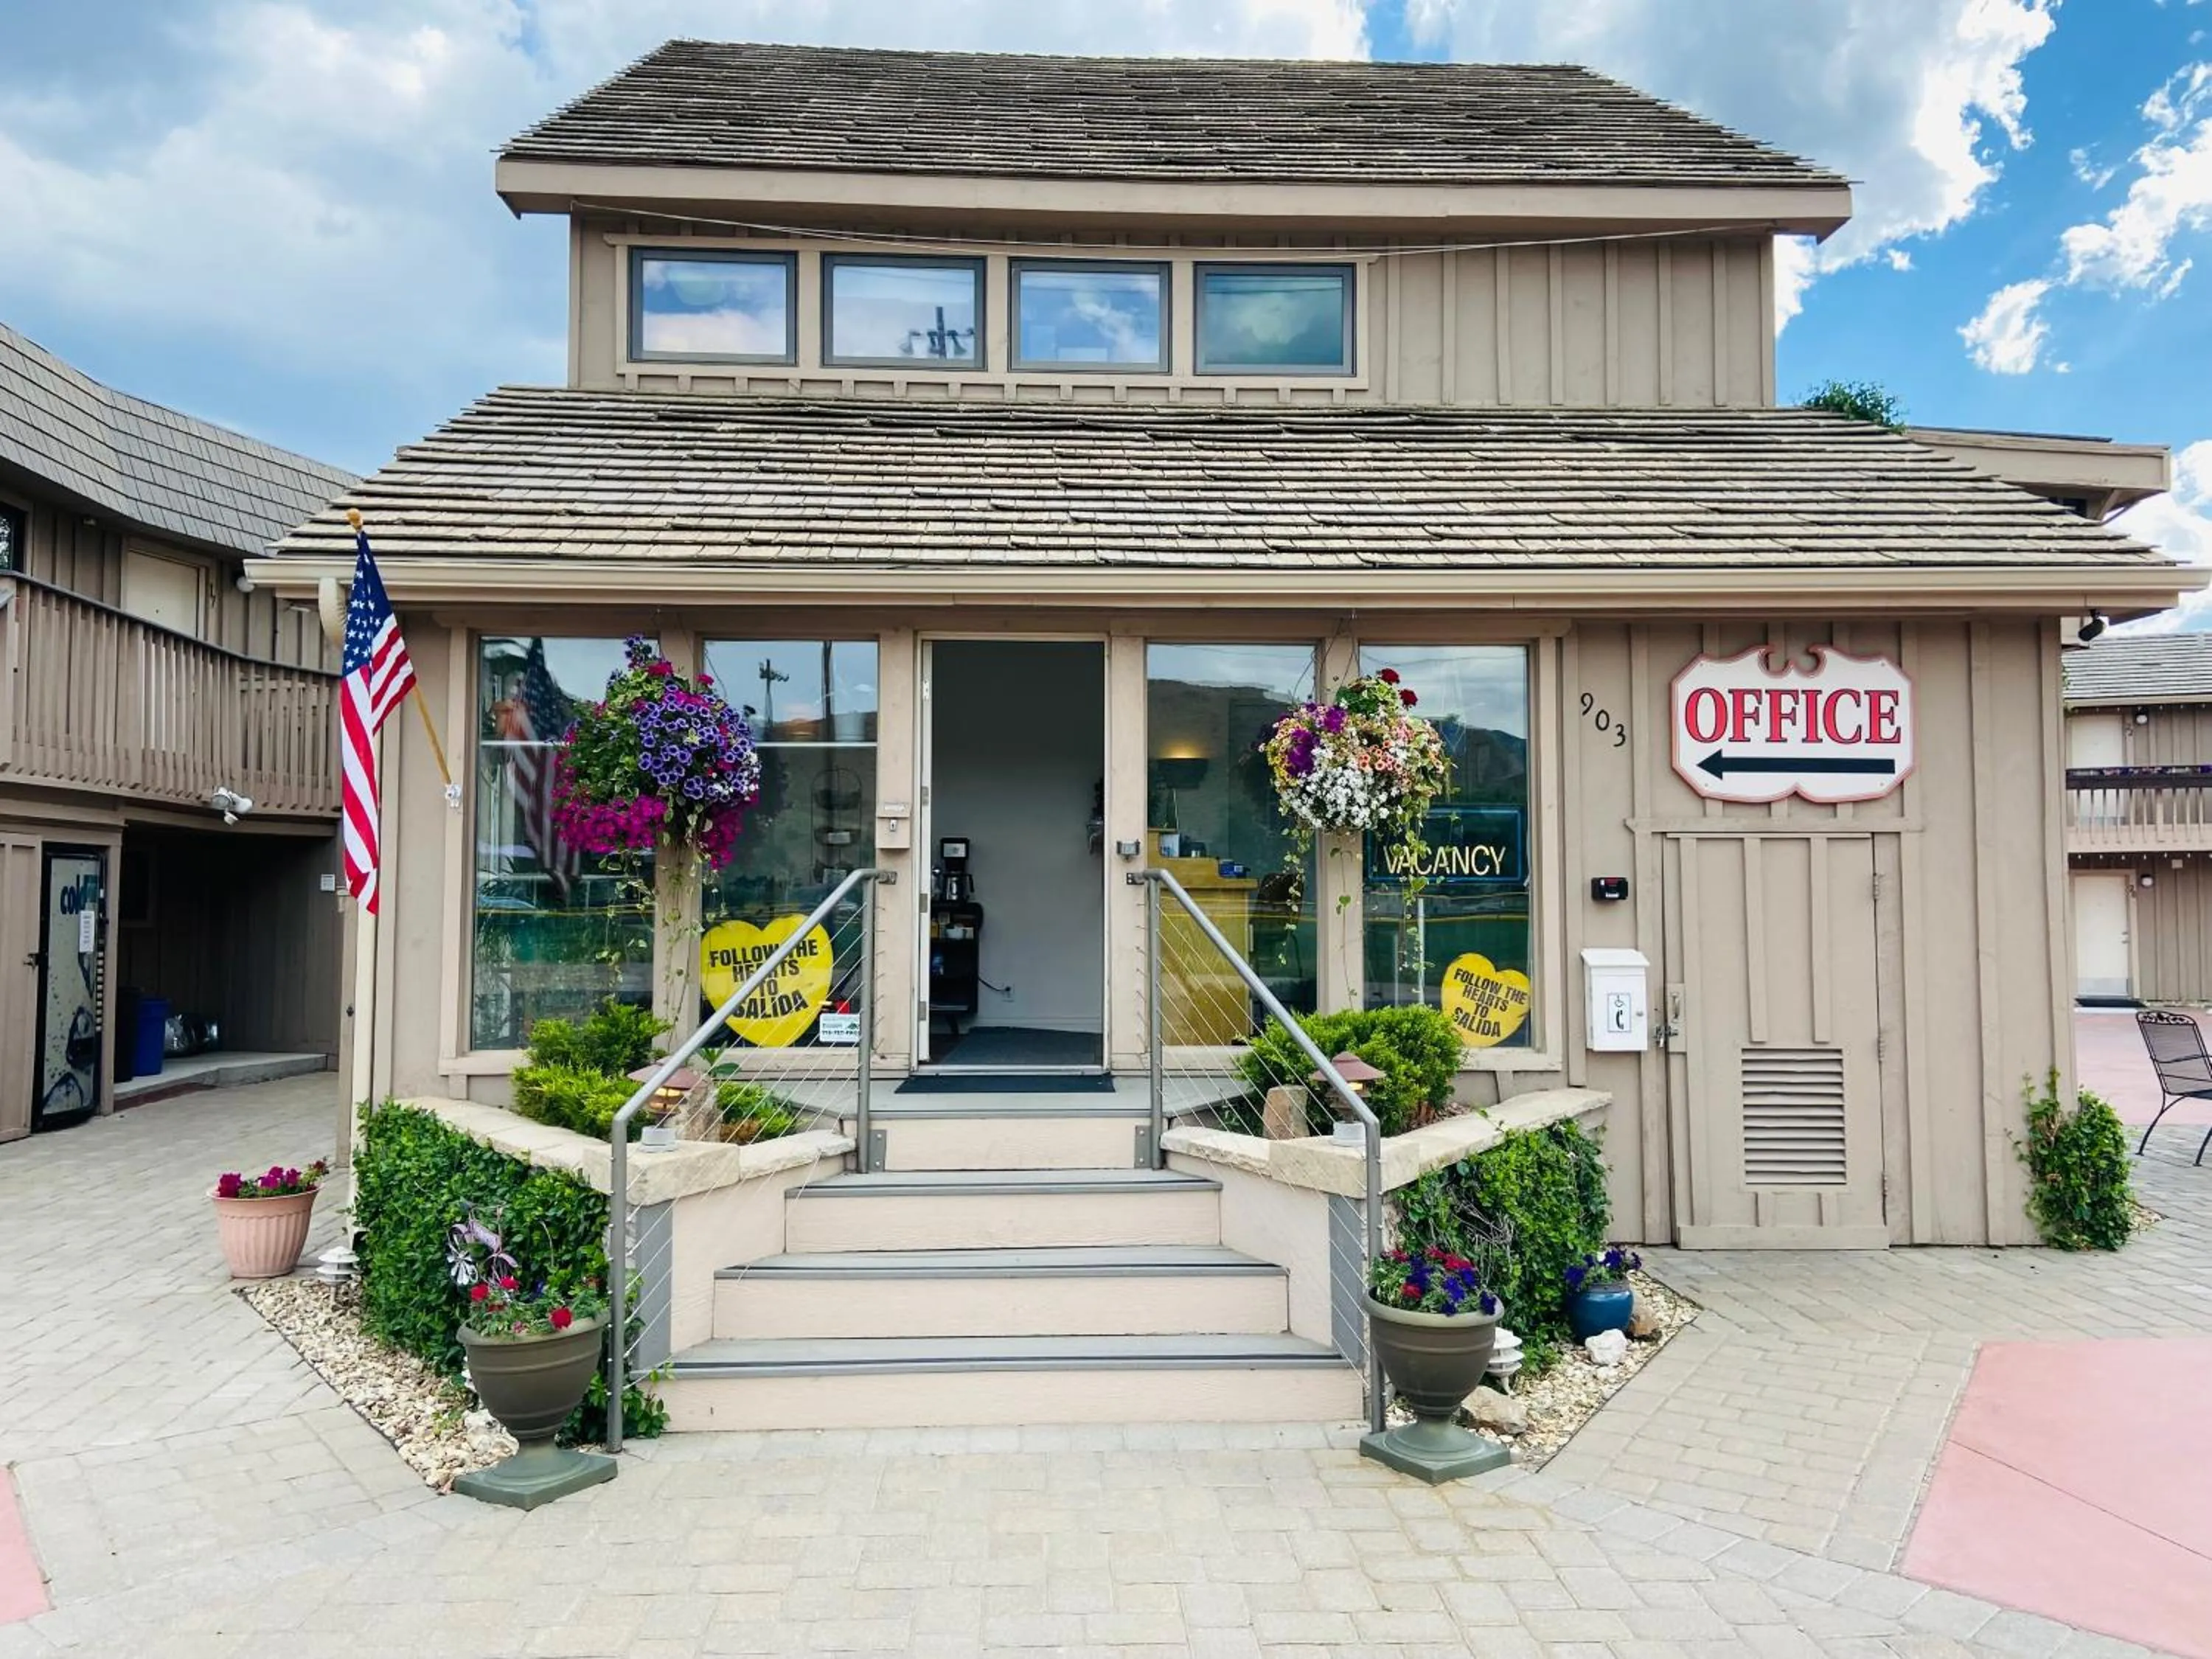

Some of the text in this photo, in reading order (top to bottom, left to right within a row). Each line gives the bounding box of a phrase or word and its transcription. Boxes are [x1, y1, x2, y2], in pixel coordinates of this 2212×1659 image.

[1580, 692, 1626, 747] 903
[1684, 687, 1902, 744] OFFICE
[1382, 844, 1507, 876] VACANCY
[709, 943, 779, 967] FOLLOW
[1453, 968, 1528, 1005] FOLLOW THE
[1462, 984, 1509, 1012] HEARTS
[1452, 1006, 1501, 1037] SALIDA
[1473, 1002, 1489, 1018] TO
